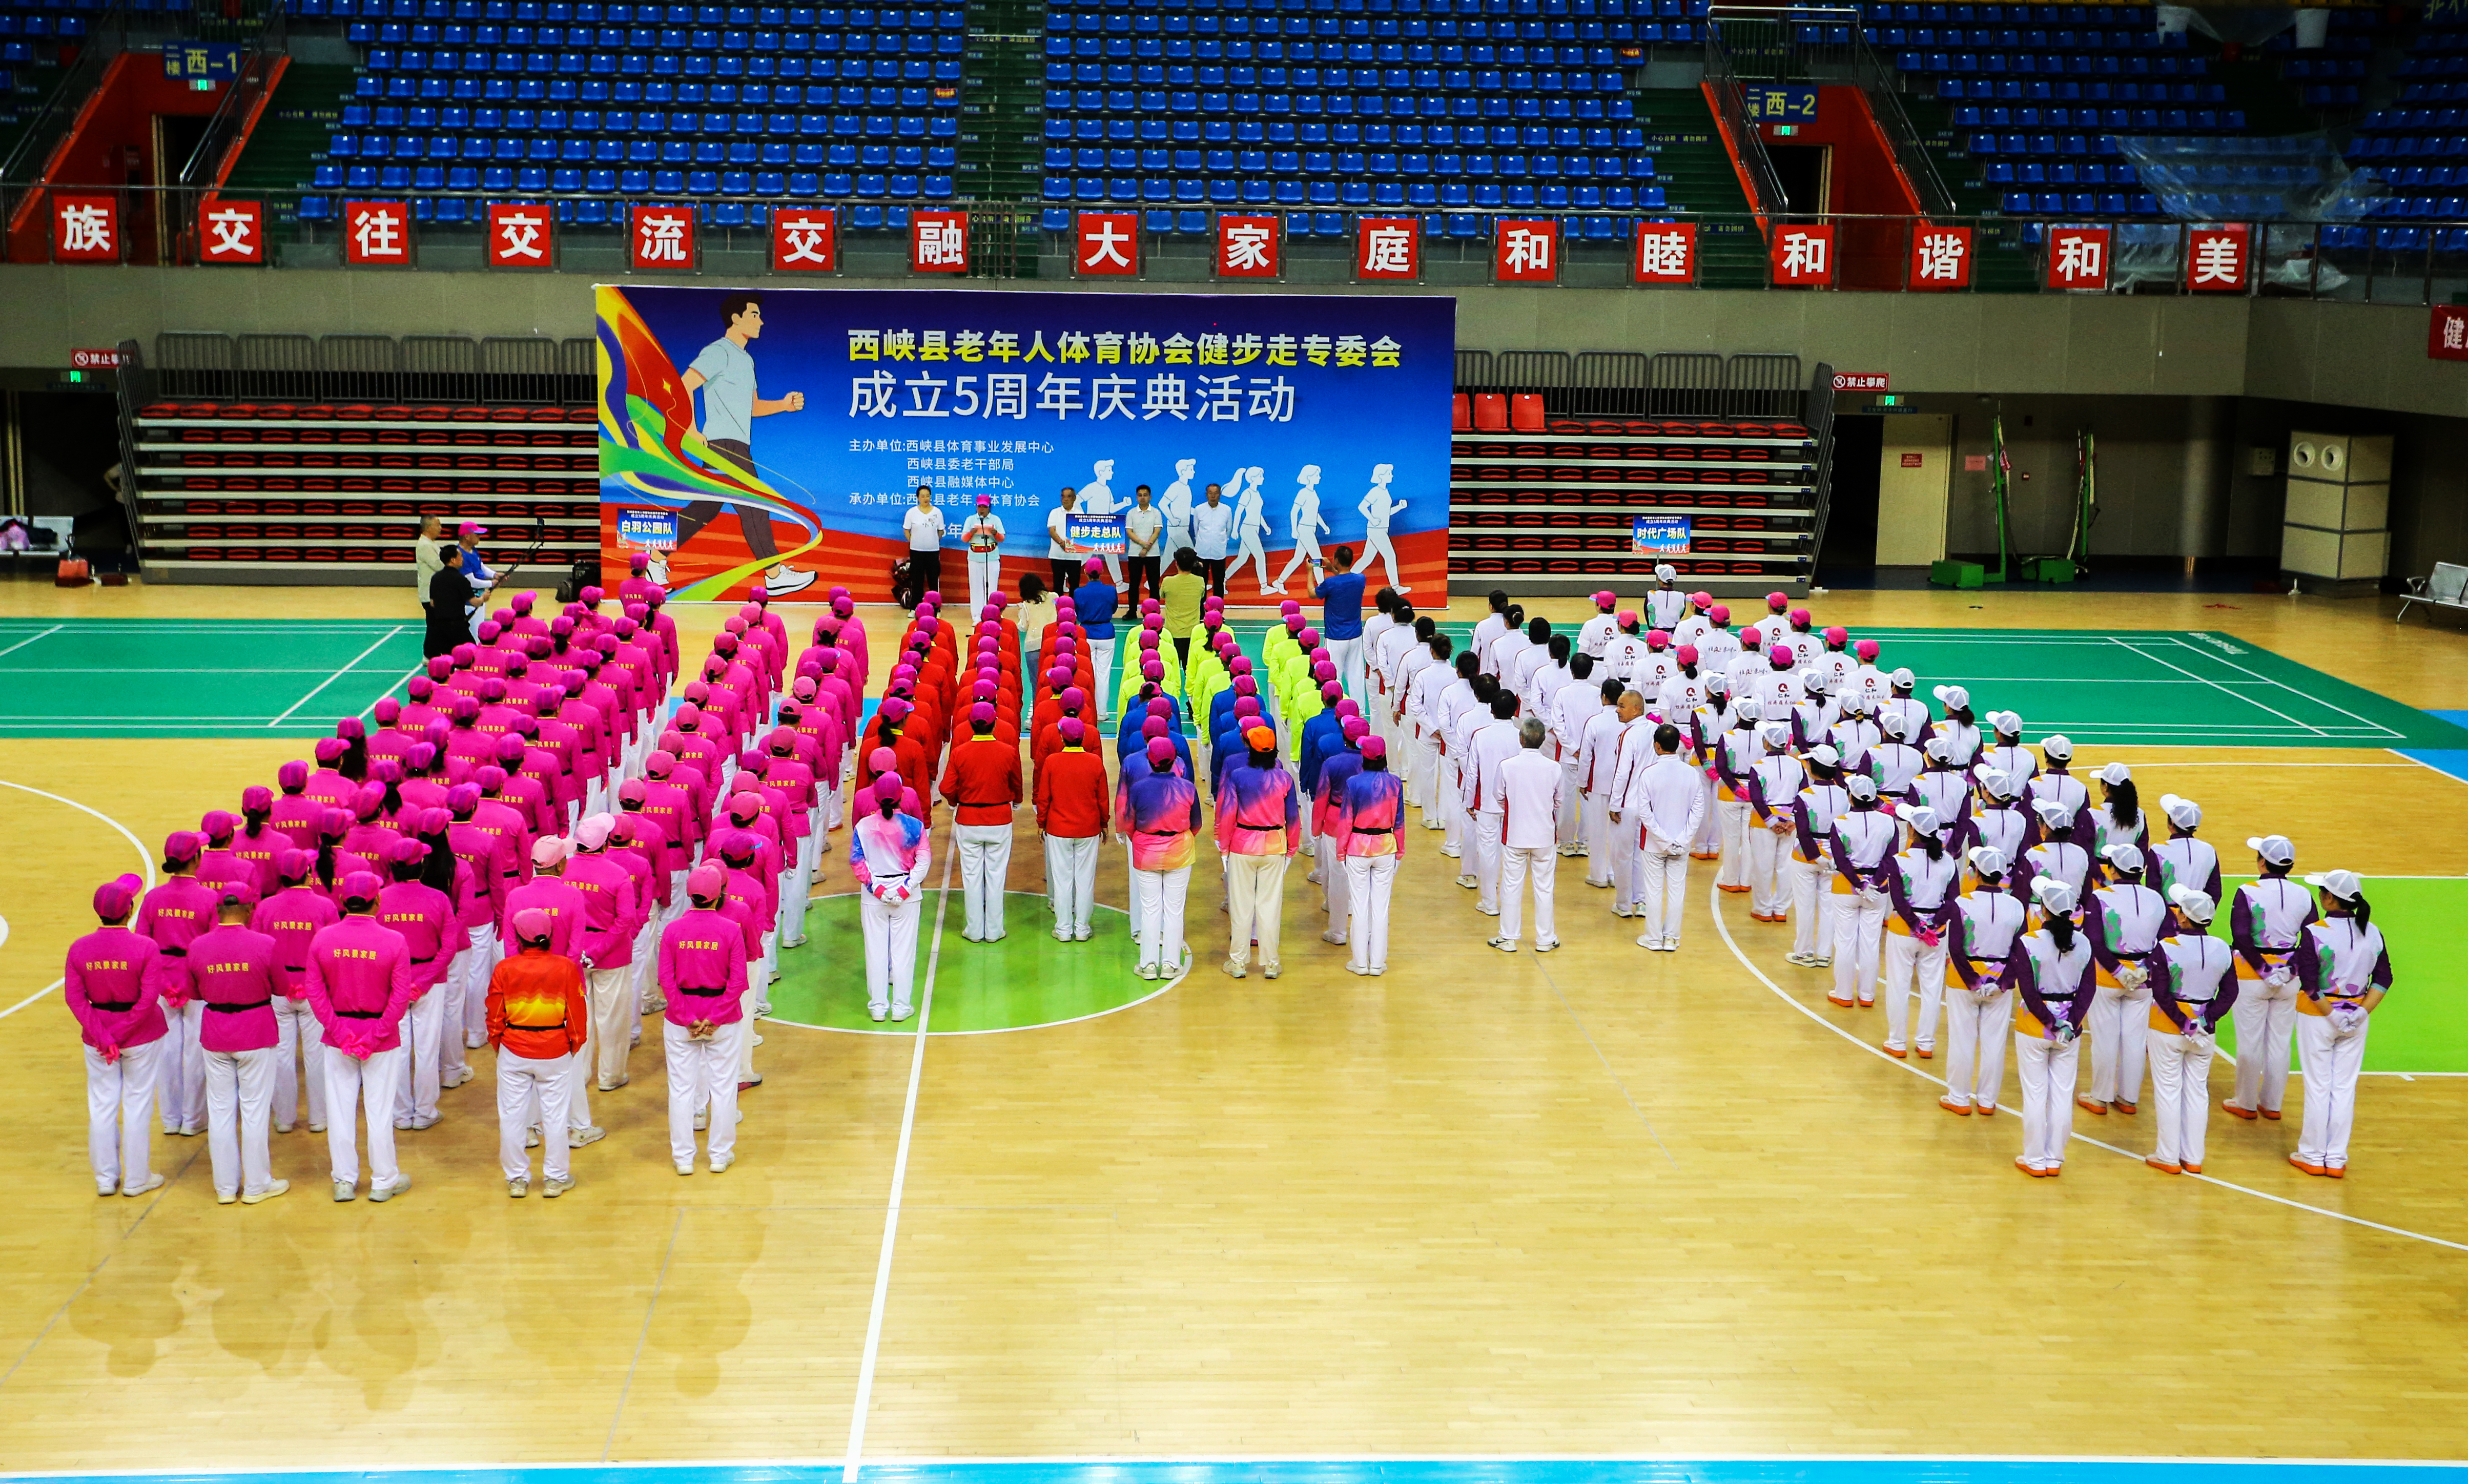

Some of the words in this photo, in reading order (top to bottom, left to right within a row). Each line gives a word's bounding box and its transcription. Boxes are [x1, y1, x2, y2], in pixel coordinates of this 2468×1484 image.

[184, 49, 237, 74] 西-1
[1765, 92, 1816, 116] 西-2
[61, 205, 110, 251] 族
[209, 209, 254, 255] 交
[355, 210, 402, 257] 往
[498, 213, 543, 258] 交
[640, 215, 686, 261] 流
[782, 218, 826, 263] 交
[917, 219, 964, 265] 融
[1085, 221, 1130, 267] 大
[1226, 224, 1270, 270] 家
[1365, 226, 1410, 272] 庭
[1505, 229, 1549, 274] 和
[1642, 232, 1687, 275] 睦
[1782, 233, 1825, 277] 和
[1919, 234, 1964, 279] 谐
[2057, 237, 2101, 281] 和
[2194, 238, 2237, 283] 美
[2443, 316, 2468, 349] 健
[848, 329, 1402, 367] 西峡县老年人体育协会健步走专委会
[1847, 377, 1885, 388] 禁止攀爬
[849, 369, 1295, 422] 成立5周年庆典活动
[849, 439, 1054, 454] 主办单位:西峡县体育事业发展中心
[908, 457, 1014, 471] 西峡县委老干部局
[907, 475, 1014, 489] 西峡县融媒体中心
[849, 492, 1040, 507] 承办单位:西县老年体育协会
[622, 520, 672, 534] 白羽公园队
[1070, 526, 1121, 538] 健步走总队
[1637, 527, 1687, 539] 时代广场队
[378, 820, 398, 829] 景家居
[236, 851, 271, 859] 好风景家居
[158, 909, 195, 919] 好风景家居
[384, 913, 423, 922] 好风景家居
[274, 921, 312, 931] 好风景家居
[679, 940, 718, 951] 好风景家居
[334, 949, 377, 960] 好风景家居
[86, 961, 127, 971] 好风景家居
[207, 962, 250, 973] 好风景家居
